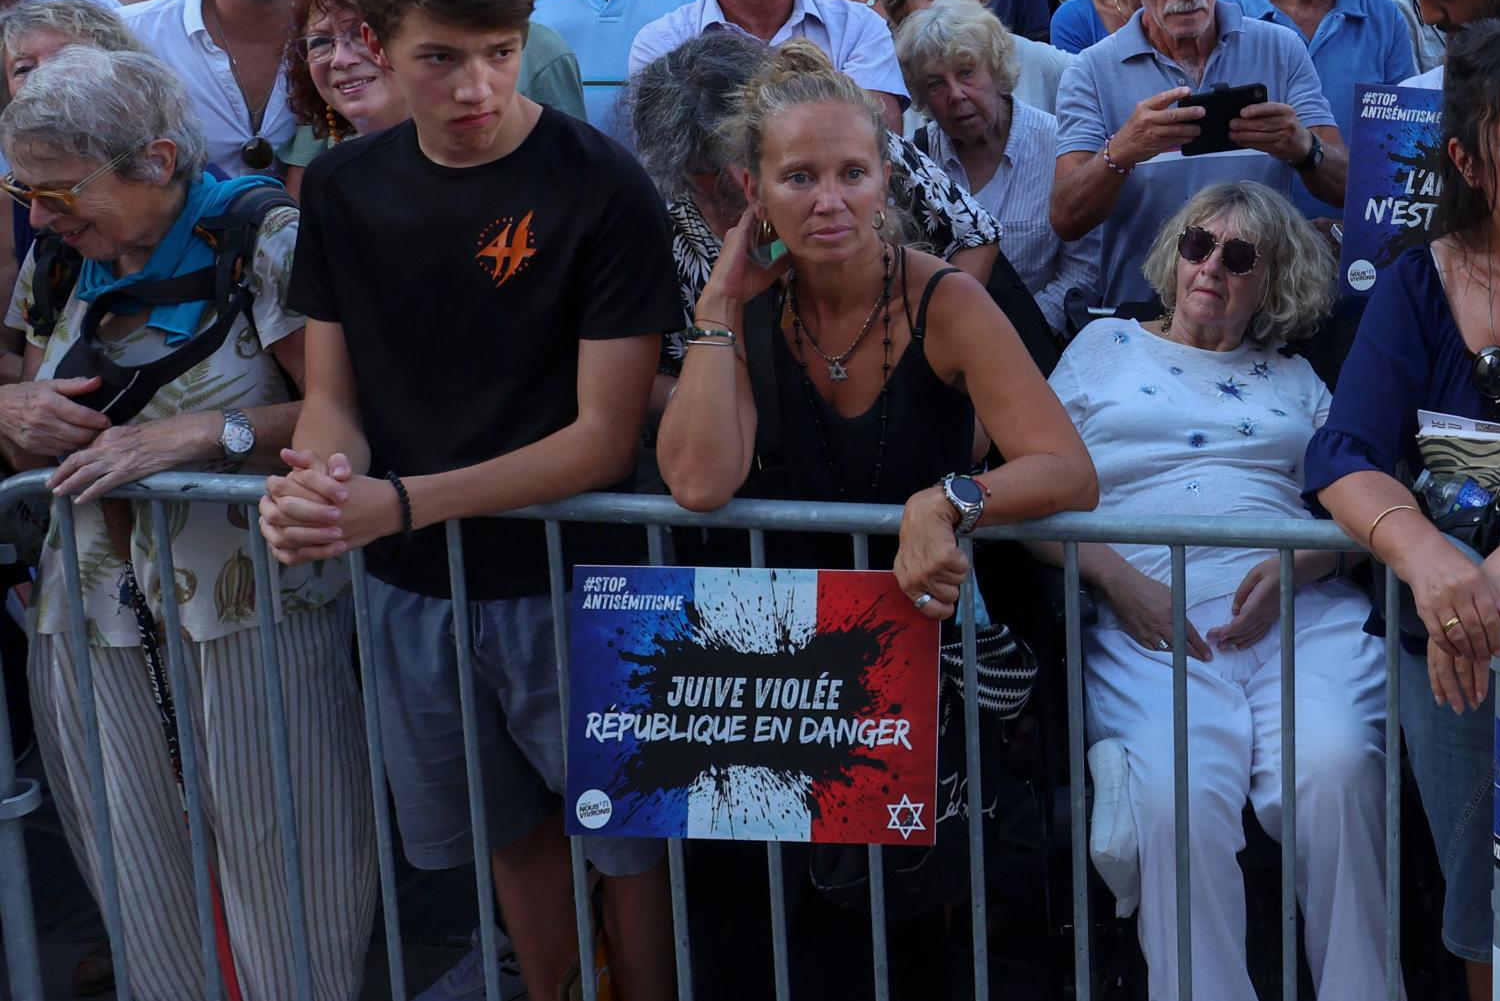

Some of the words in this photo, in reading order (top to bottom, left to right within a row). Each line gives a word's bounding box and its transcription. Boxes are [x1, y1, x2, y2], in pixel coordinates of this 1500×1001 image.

[1361, 91, 1397, 105] #STOP
[1364, 197, 1440, 232] N'EST
[583, 576, 627, 594] #STOP
[582, 589, 685, 612] ANTISÉMITISME
[667, 675, 748, 708] JUIVE
[754, 671, 844, 711] VIOLÉE
[585, 704, 747, 743] RÉPUBLIQUE
[753, 715, 793, 743] EN
[799, 716, 913, 750] DANGER
[579, 803, 600, 812] NOUS
[579, 808, 610, 819] VIVRONS
